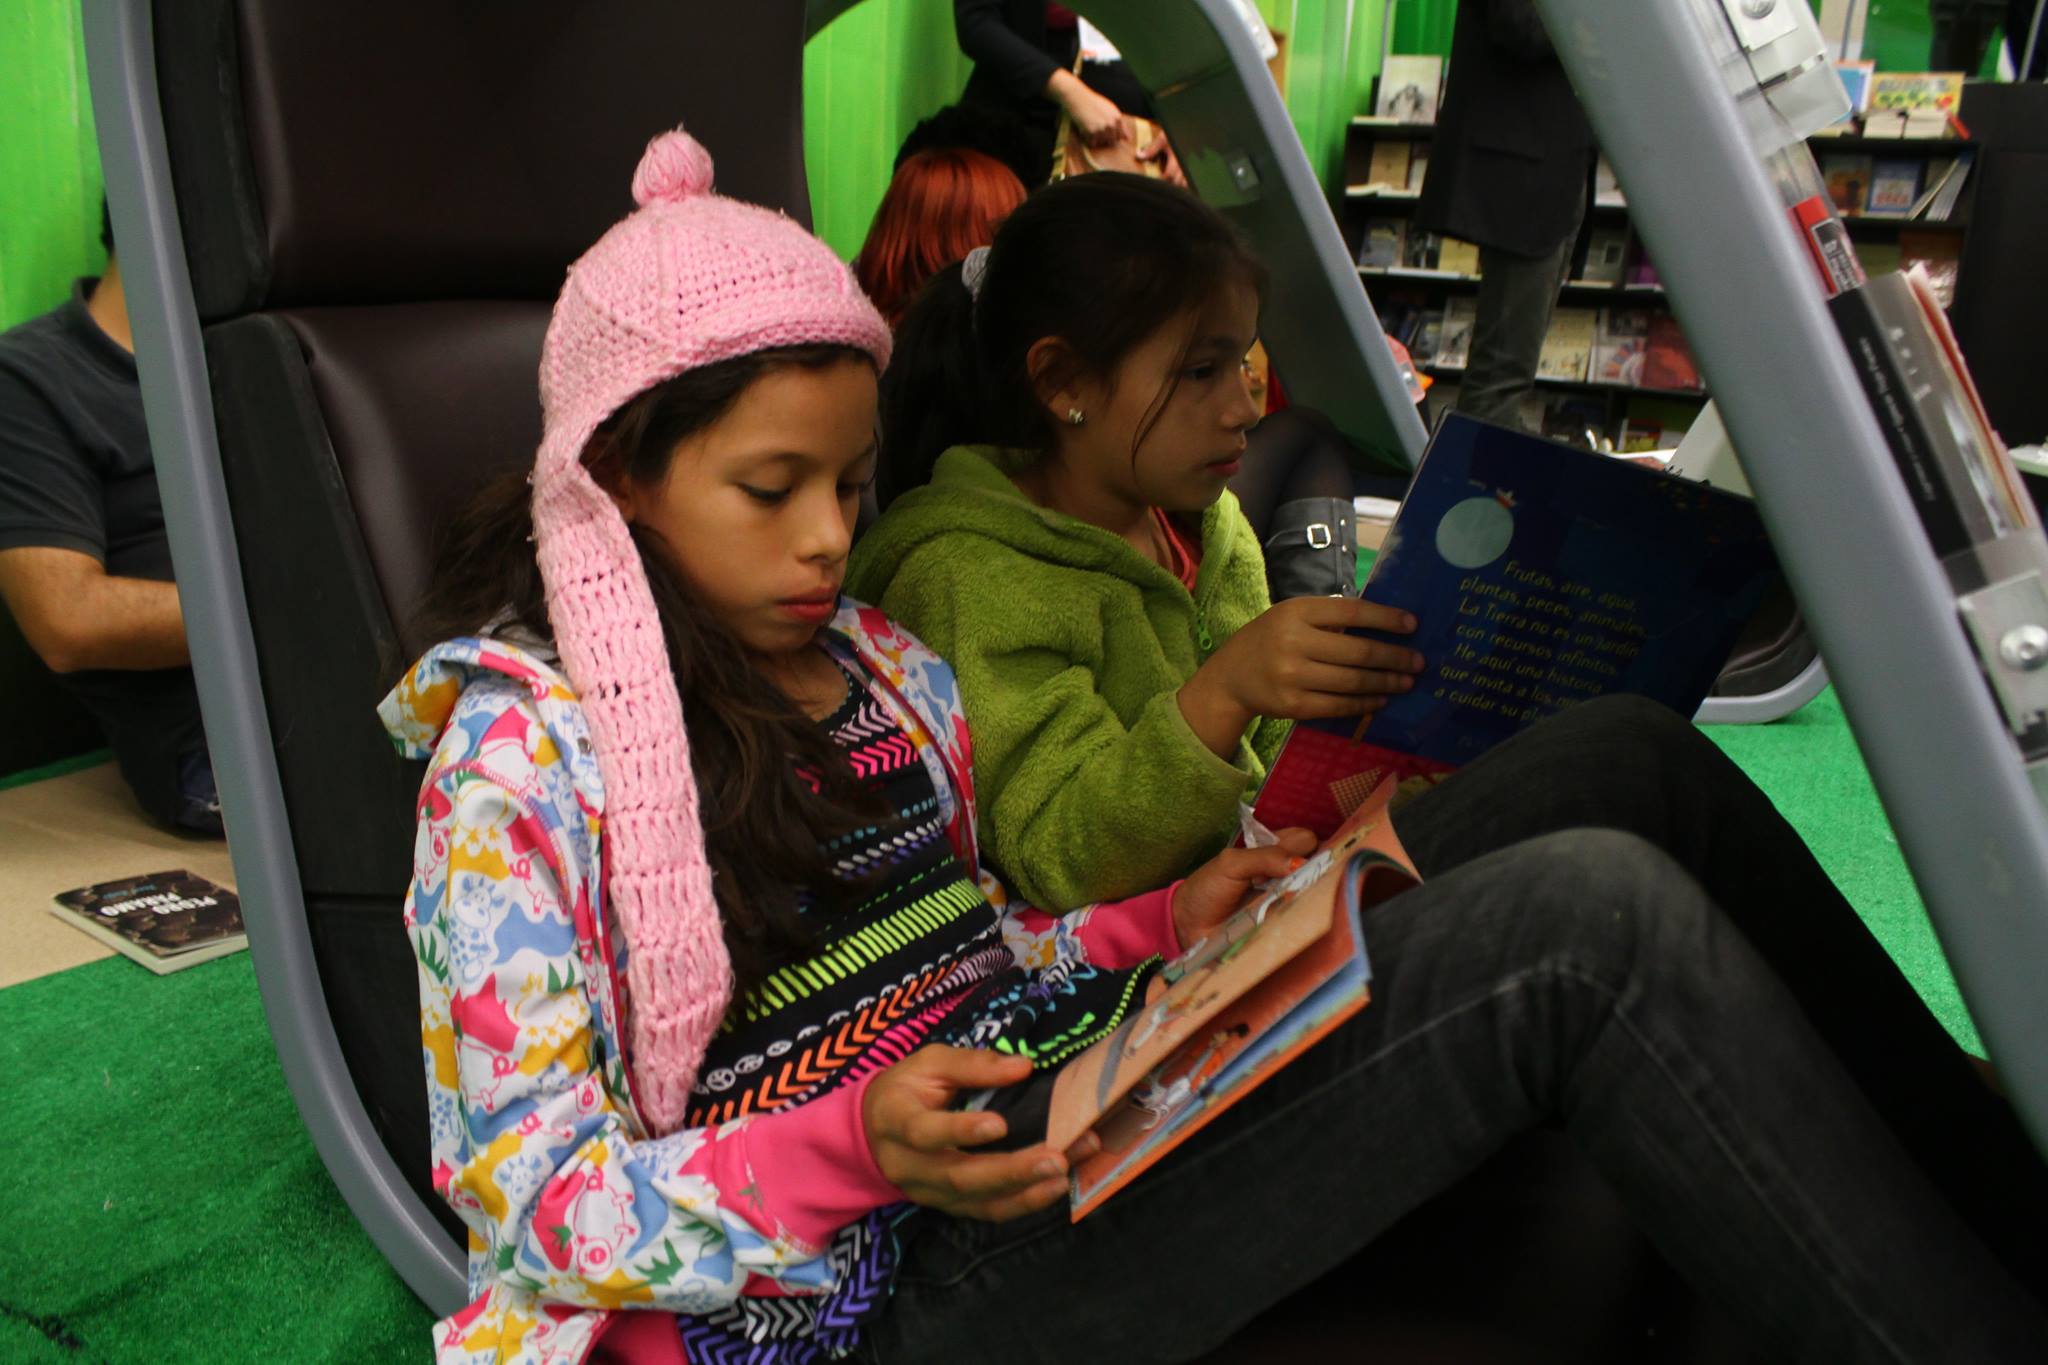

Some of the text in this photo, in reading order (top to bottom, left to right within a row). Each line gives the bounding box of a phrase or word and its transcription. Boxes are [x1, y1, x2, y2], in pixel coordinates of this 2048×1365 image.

[1459, 575, 1521, 605] plantas,
[1525, 592, 1574, 619] peces,
[1503, 560, 1554, 590] Frutas,
[1559, 580, 1592, 602] aire,
[1455, 622, 1485, 641] con
[1488, 631, 1553, 660] recursos
[1458, 598, 1478, 618] La
[1485, 601, 1528, 631] Tierra
[1530, 620, 1550, 634] no
[1552, 625, 1570, 640] es
[1575, 631, 1593, 647] un
[1440, 663, 1468, 682] que
[1472, 672, 1514, 695] invita
[1516, 684, 1529, 699] a
[1530, 683, 1554, 705] los
[1454, 642, 1603, 695] He aquí una historia
[1434, 685, 1445, 700] a
[1448, 688, 1497, 712] cuidar
[1499, 702, 1519, 718] su
[152, 895, 218, 915] PEDRO
